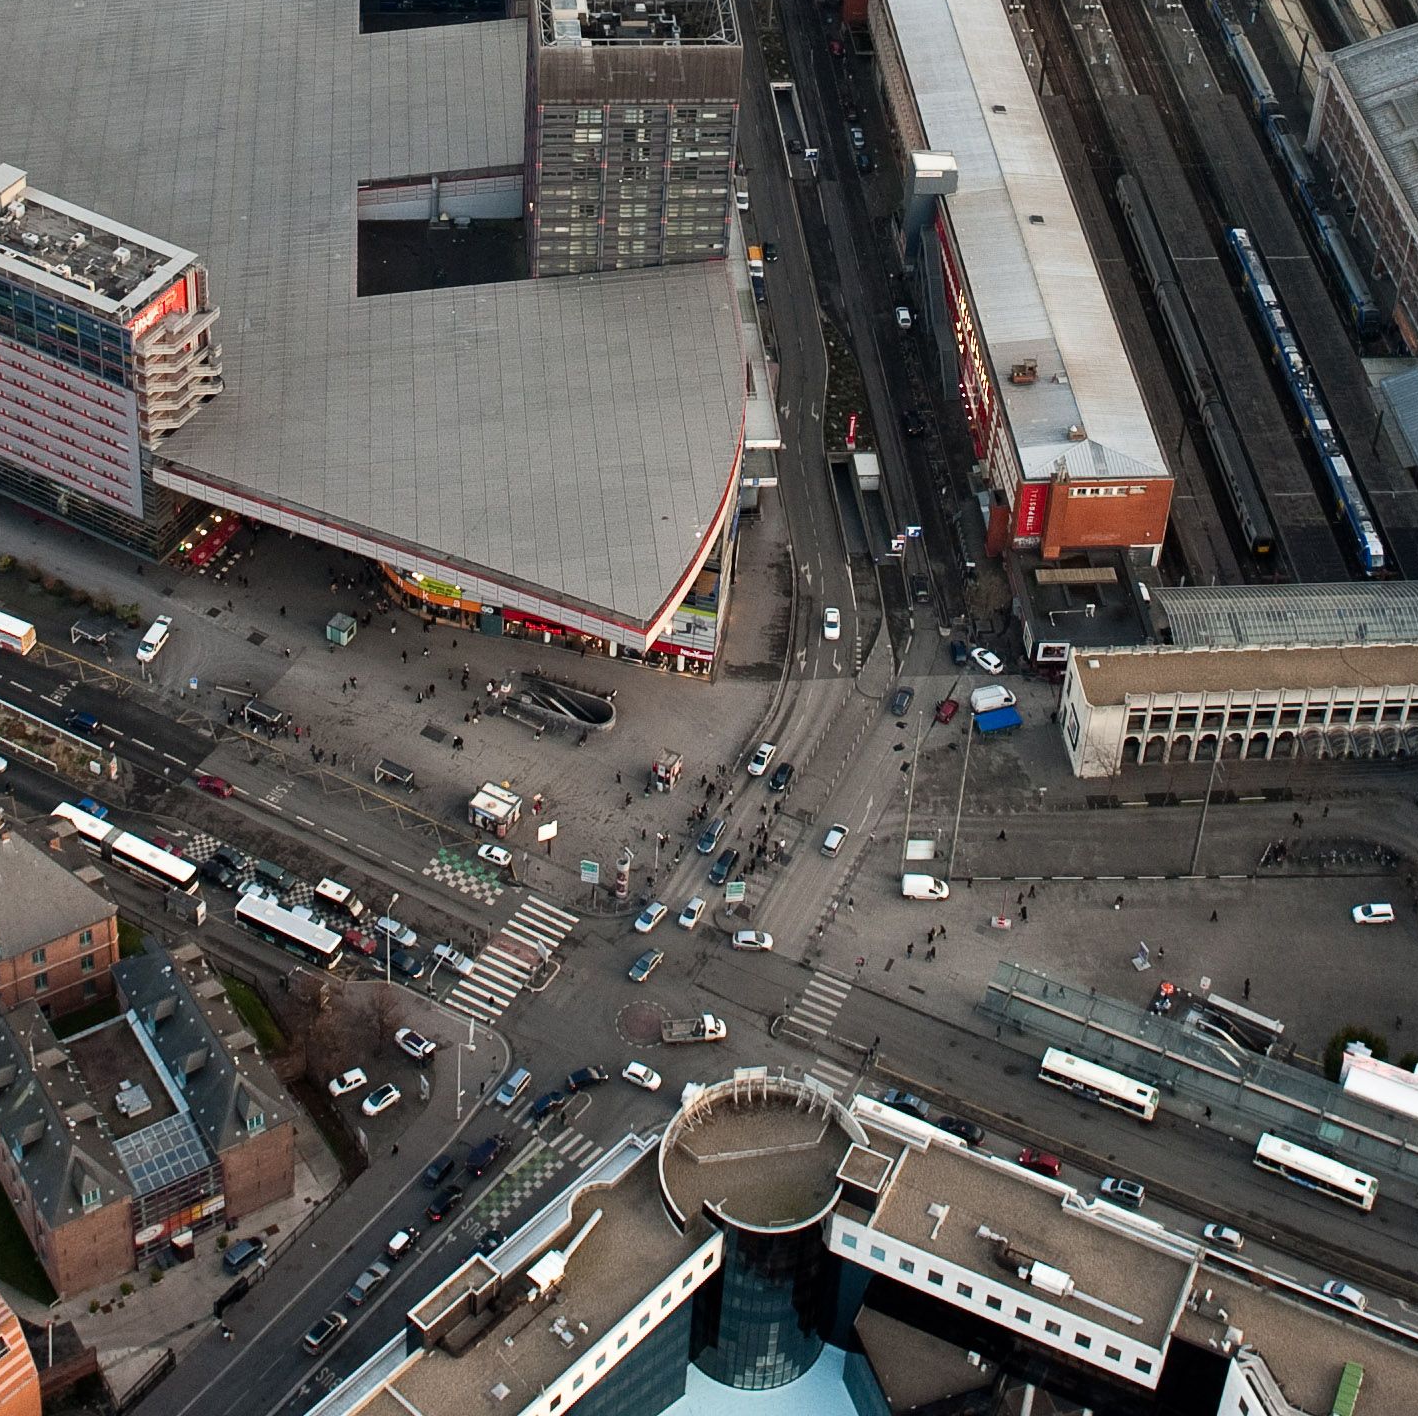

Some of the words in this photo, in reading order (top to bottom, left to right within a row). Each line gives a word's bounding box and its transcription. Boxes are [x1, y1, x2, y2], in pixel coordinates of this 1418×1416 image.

[50, 684, 72, 701] BUS
[266, 784, 288, 803] BUS
[461, 1217, 488, 1240] BUS
